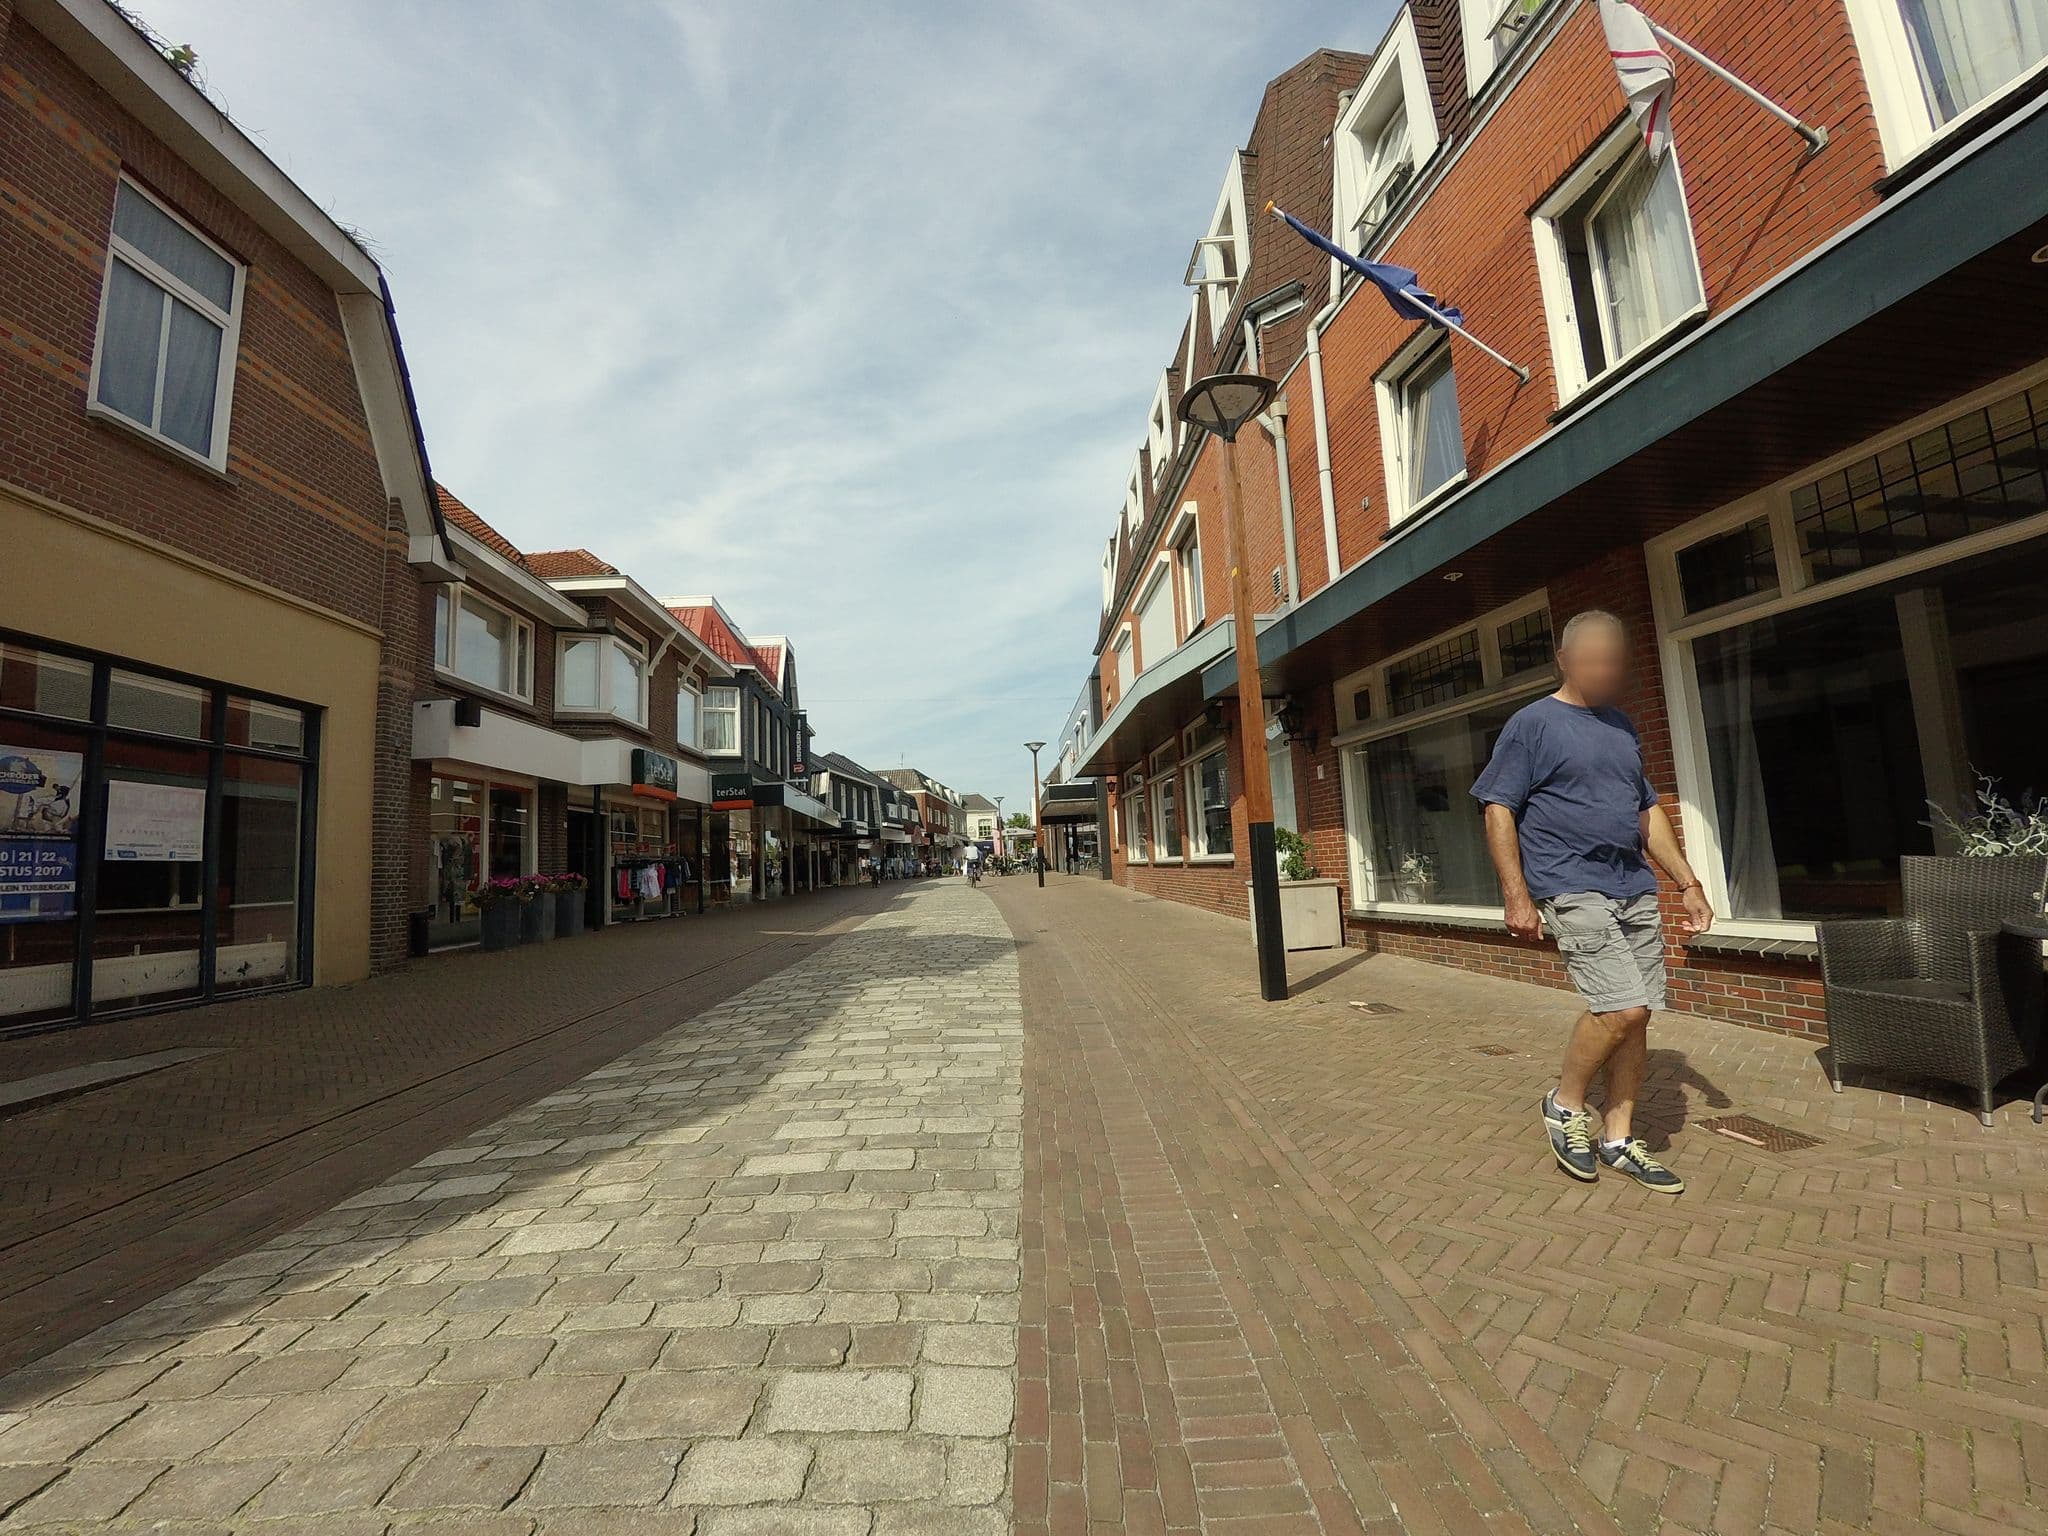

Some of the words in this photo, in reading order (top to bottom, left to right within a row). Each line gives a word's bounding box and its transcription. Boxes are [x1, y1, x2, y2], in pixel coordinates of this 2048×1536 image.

[716, 787, 747, 797] terStal
[19, 851, 32, 862] 21
[41, 852, 56, 862] 22
[34, 866, 63, 876] 2017
